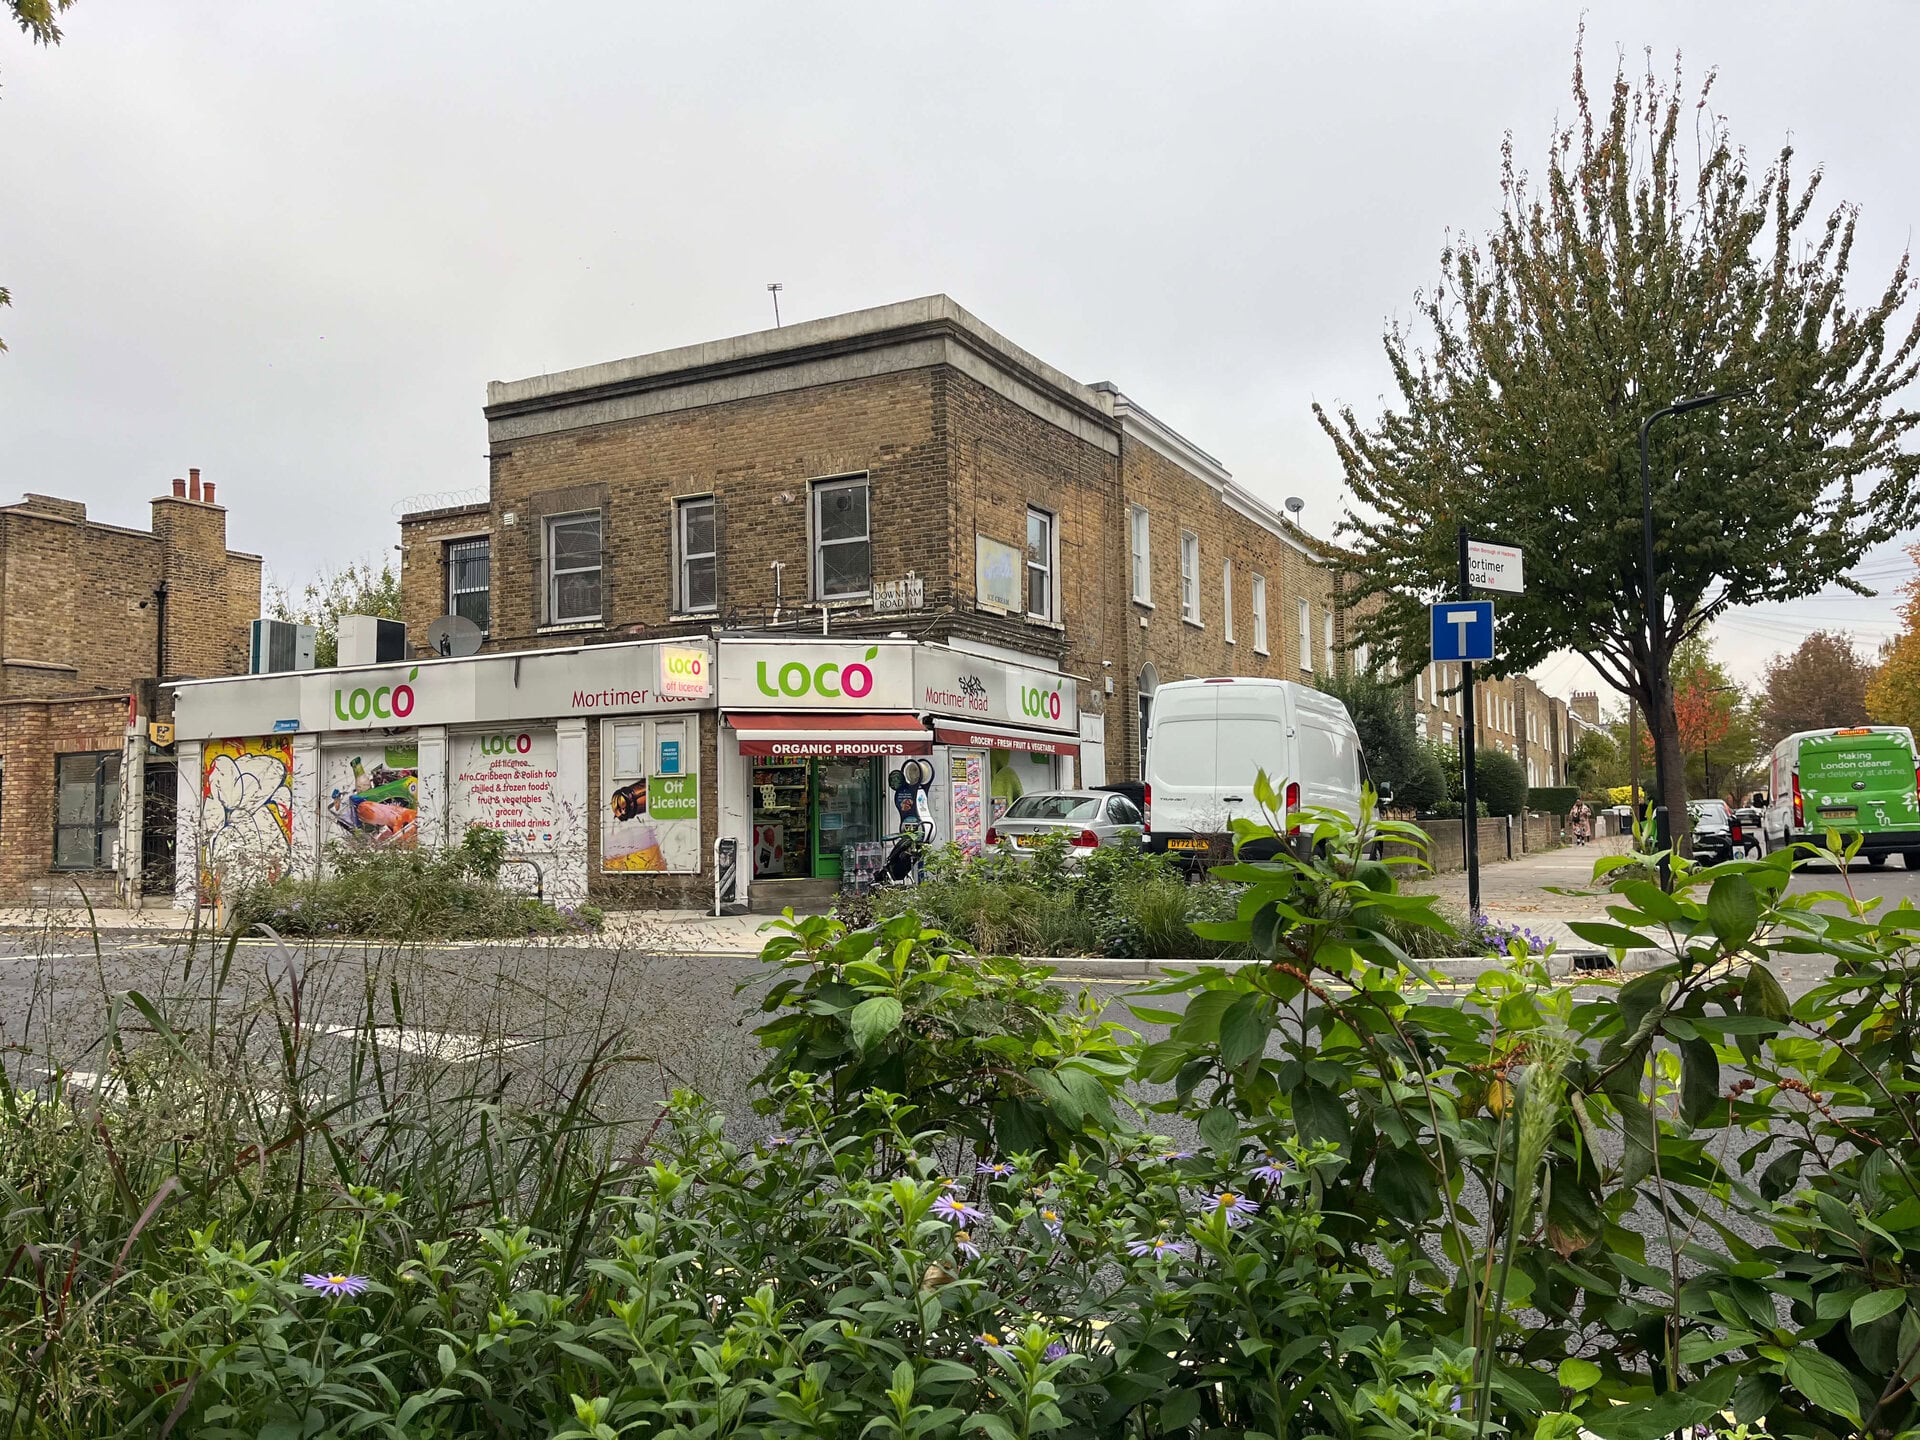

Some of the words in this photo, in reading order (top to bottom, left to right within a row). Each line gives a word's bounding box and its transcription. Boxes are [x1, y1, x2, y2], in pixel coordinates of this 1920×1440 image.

[1470, 573, 1486, 583] oad
[875, 588, 921, 600] DOWNHAM
[880, 599, 903, 609] ROAD
[669, 657, 701, 675] LOCO
[757, 661, 873, 698] LOCO
[666, 680, 676, 692] off
[335, 684, 415, 721] LOCO
[572, 688, 648, 708] Mortimer
[925, 686, 967, 709] Mortimer
[968, 691, 988, 711] Road
[1021, 685, 1061, 720] LOCO
[481, 734, 531, 755] LOCO
[772, 744, 832, 754] ORGANIC
[835, 744, 904, 754] PRODUCTS
[970, 735, 994, 746] GROCERY
[997, 739, 1012, 748] FRESH
[1013, 740, 1026, 750] FRUIT
[1027, 742, 1031, 750] &
[1031, 743, 1055, 753] VEGETABLE
[1838, 753, 1872, 761] Making
[1821, 761, 1856, 770] London
[522, 770, 543, 779] Polish
[545, 769, 557, 778] foo
[1827, 769, 1864, 779] delivery
[471, 784, 494, 793] chilled
[503, 784, 526, 792] frozen
[528, 782, 549, 791] foods
[664, 781, 684, 794] Off
[502, 795, 542, 806] vegetables
[652, 795, 697, 809] Licence
[495, 808, 523, 817] grocery
[502, 819, 526, 828] chilled
[528, 819, 550, 827] drinks
